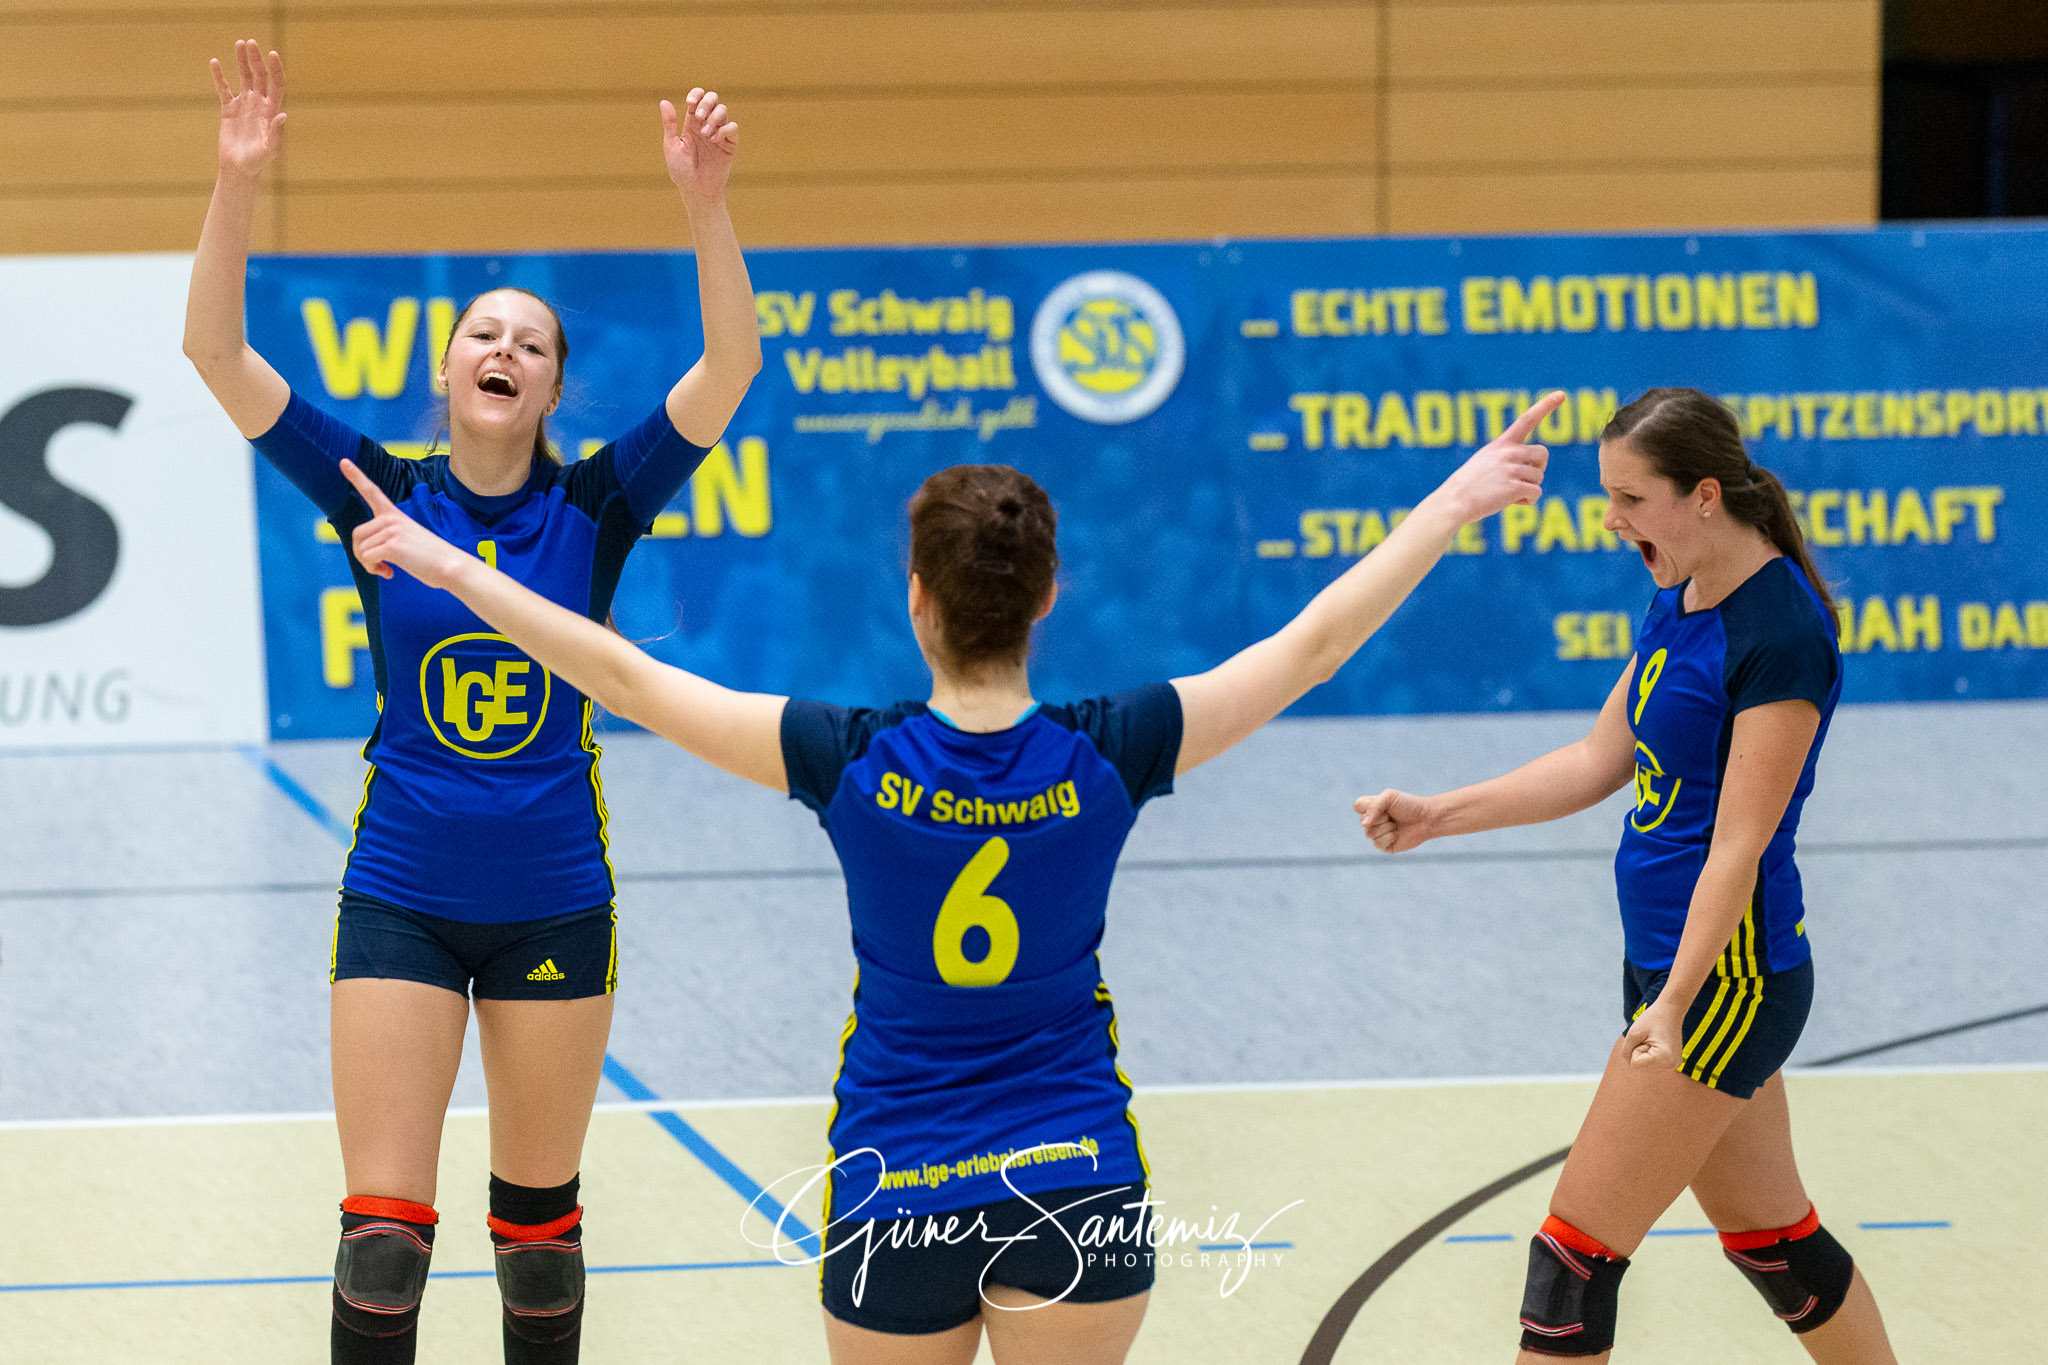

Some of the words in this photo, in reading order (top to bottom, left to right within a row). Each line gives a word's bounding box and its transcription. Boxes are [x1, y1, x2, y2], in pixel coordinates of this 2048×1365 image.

[755, 290, 817, 337] SV
[828, 287, 1016, 341] Schwaig
[1292, 287, 1449, 337] ECHTE
[1462, 271, 1819, 334] EMOTIONEN
[784, 345, 1018, 400] Volleyball
[1300, 507, 1485, 558] STAE
[441, 657, 531, 742] IGE
[1634, 647, 1669, 725] 9
[876, 771, 925, 817] SV
[930, 779, 1081, 826] Schwaig
[932, 836, 1020, 988] 6
[526, 971, 566, 981] adidas
